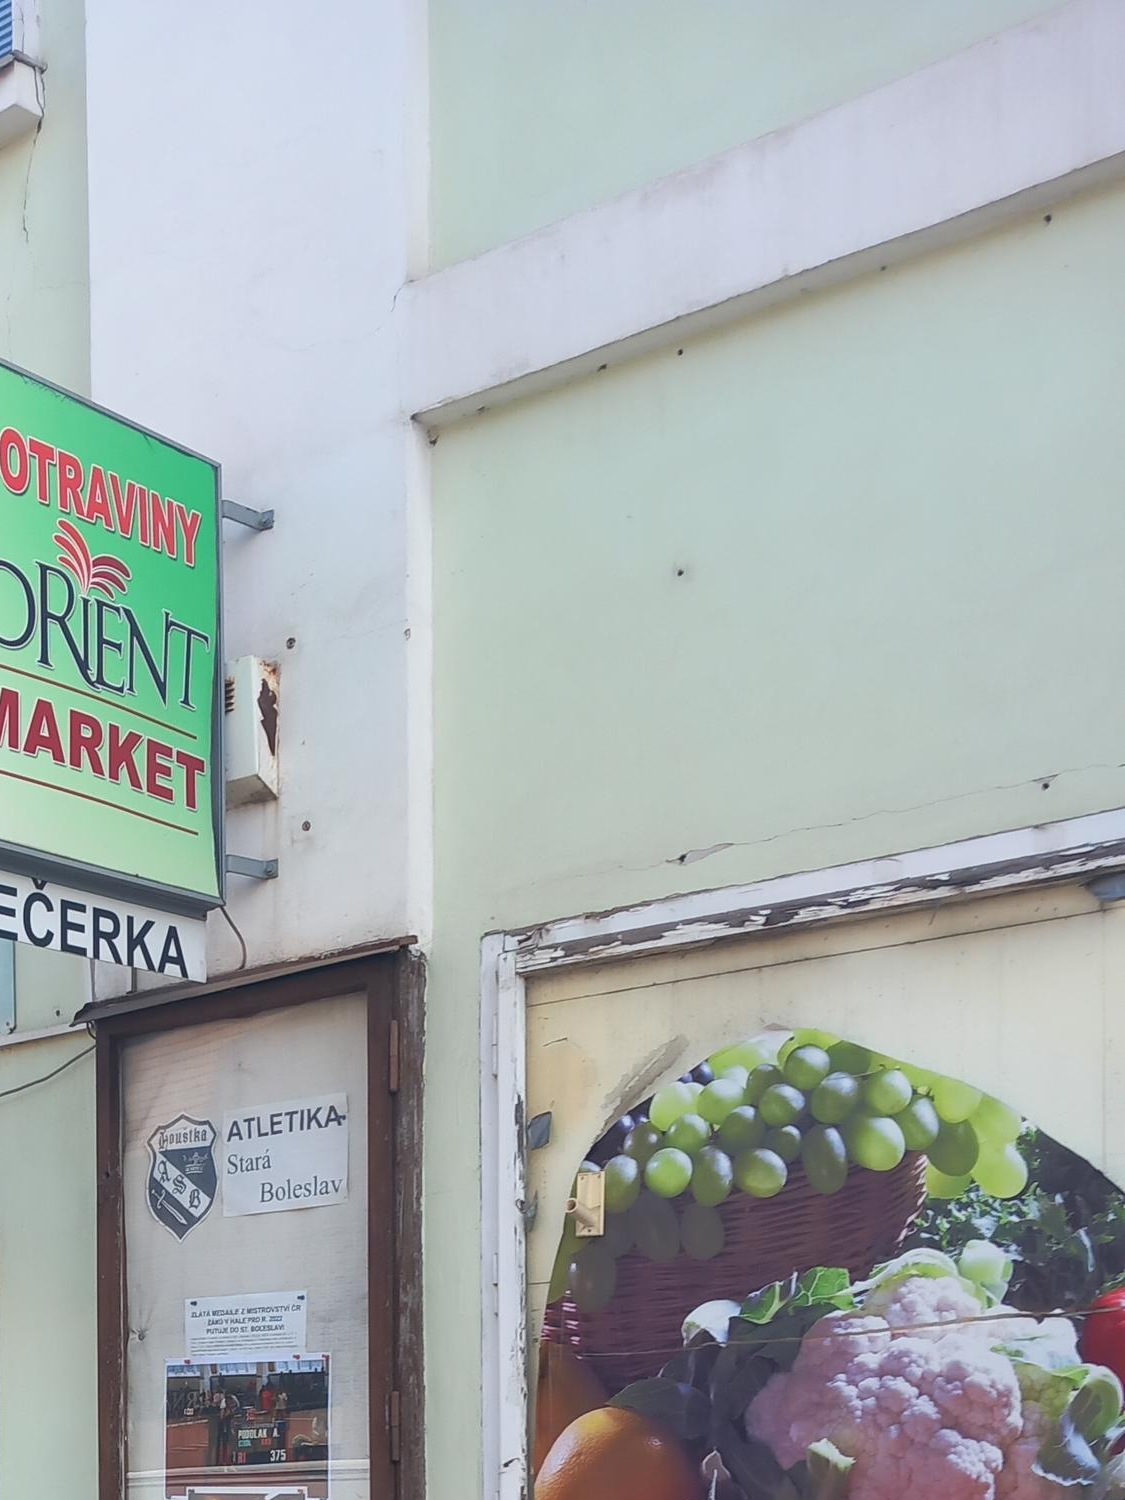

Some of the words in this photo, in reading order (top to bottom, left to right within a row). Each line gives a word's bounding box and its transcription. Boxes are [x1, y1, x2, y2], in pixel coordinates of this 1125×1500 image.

[227, 1105, 343, 1142] ATLETIKA
[227, 1149, 271, 1175] Stará
[259, 1175, 343, 1203] Boleslav
[270, 1449, 286, 1462] 375
